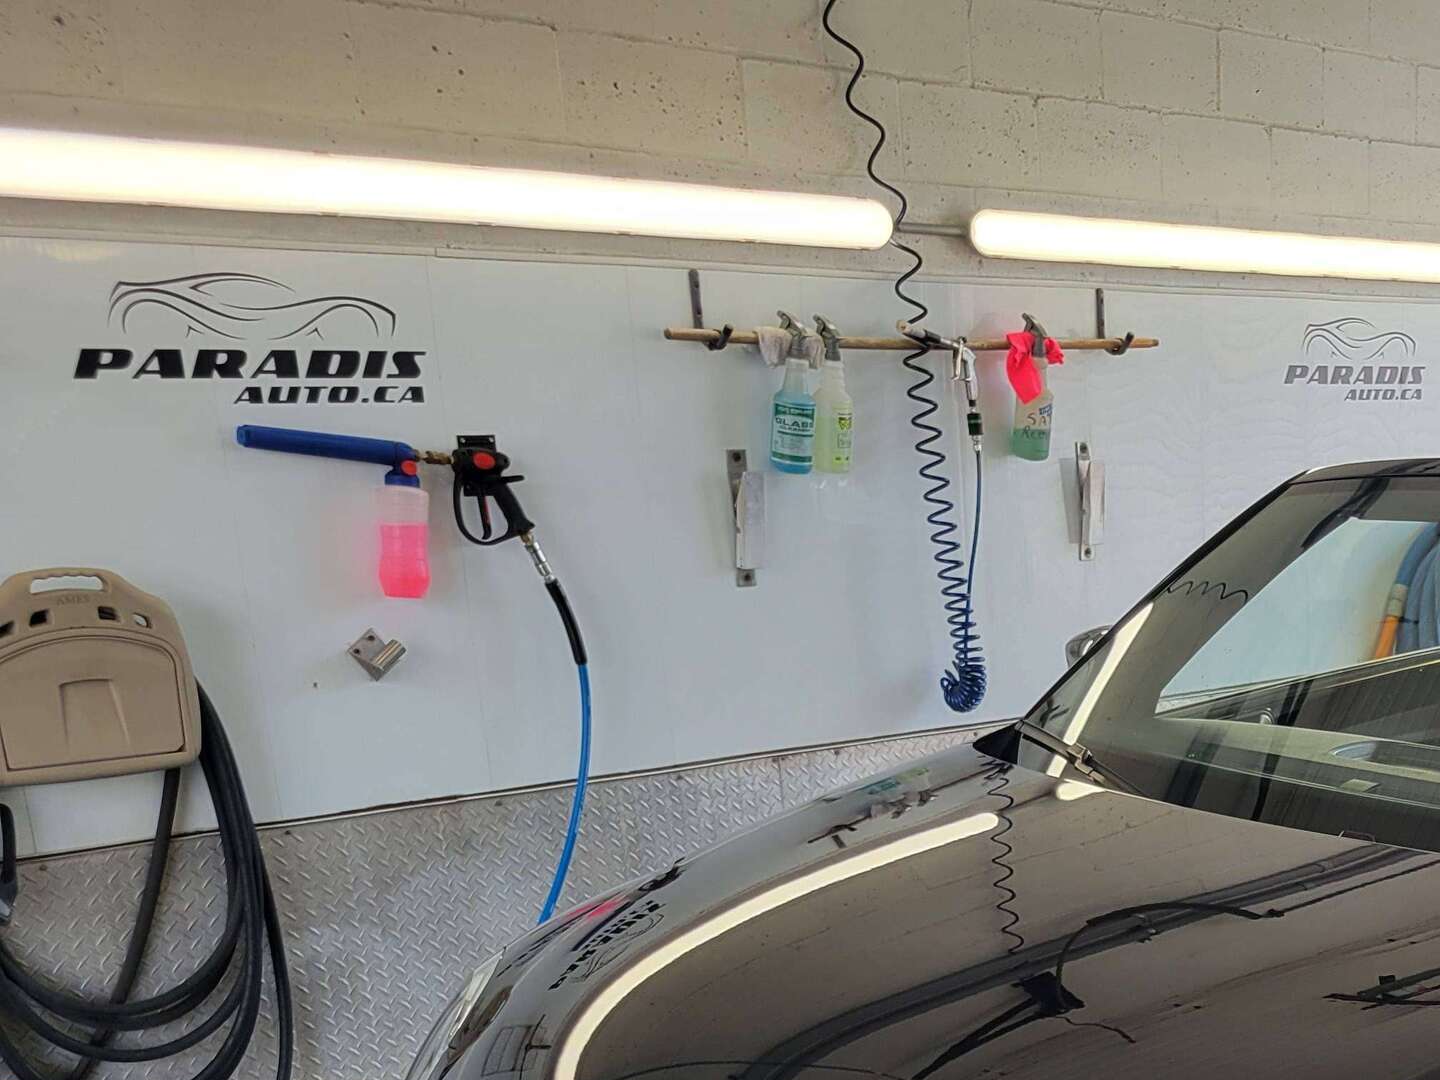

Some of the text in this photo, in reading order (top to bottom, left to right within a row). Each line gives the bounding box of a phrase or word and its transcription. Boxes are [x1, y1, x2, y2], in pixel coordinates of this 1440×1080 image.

[73, 348, 427, 380] PARADIS
[1283, 364, 1426, 385] PARADIS
[233, 385, 426, 405] AUTO.CA
[1343, 388, 1422, 401] AUTO.CA
